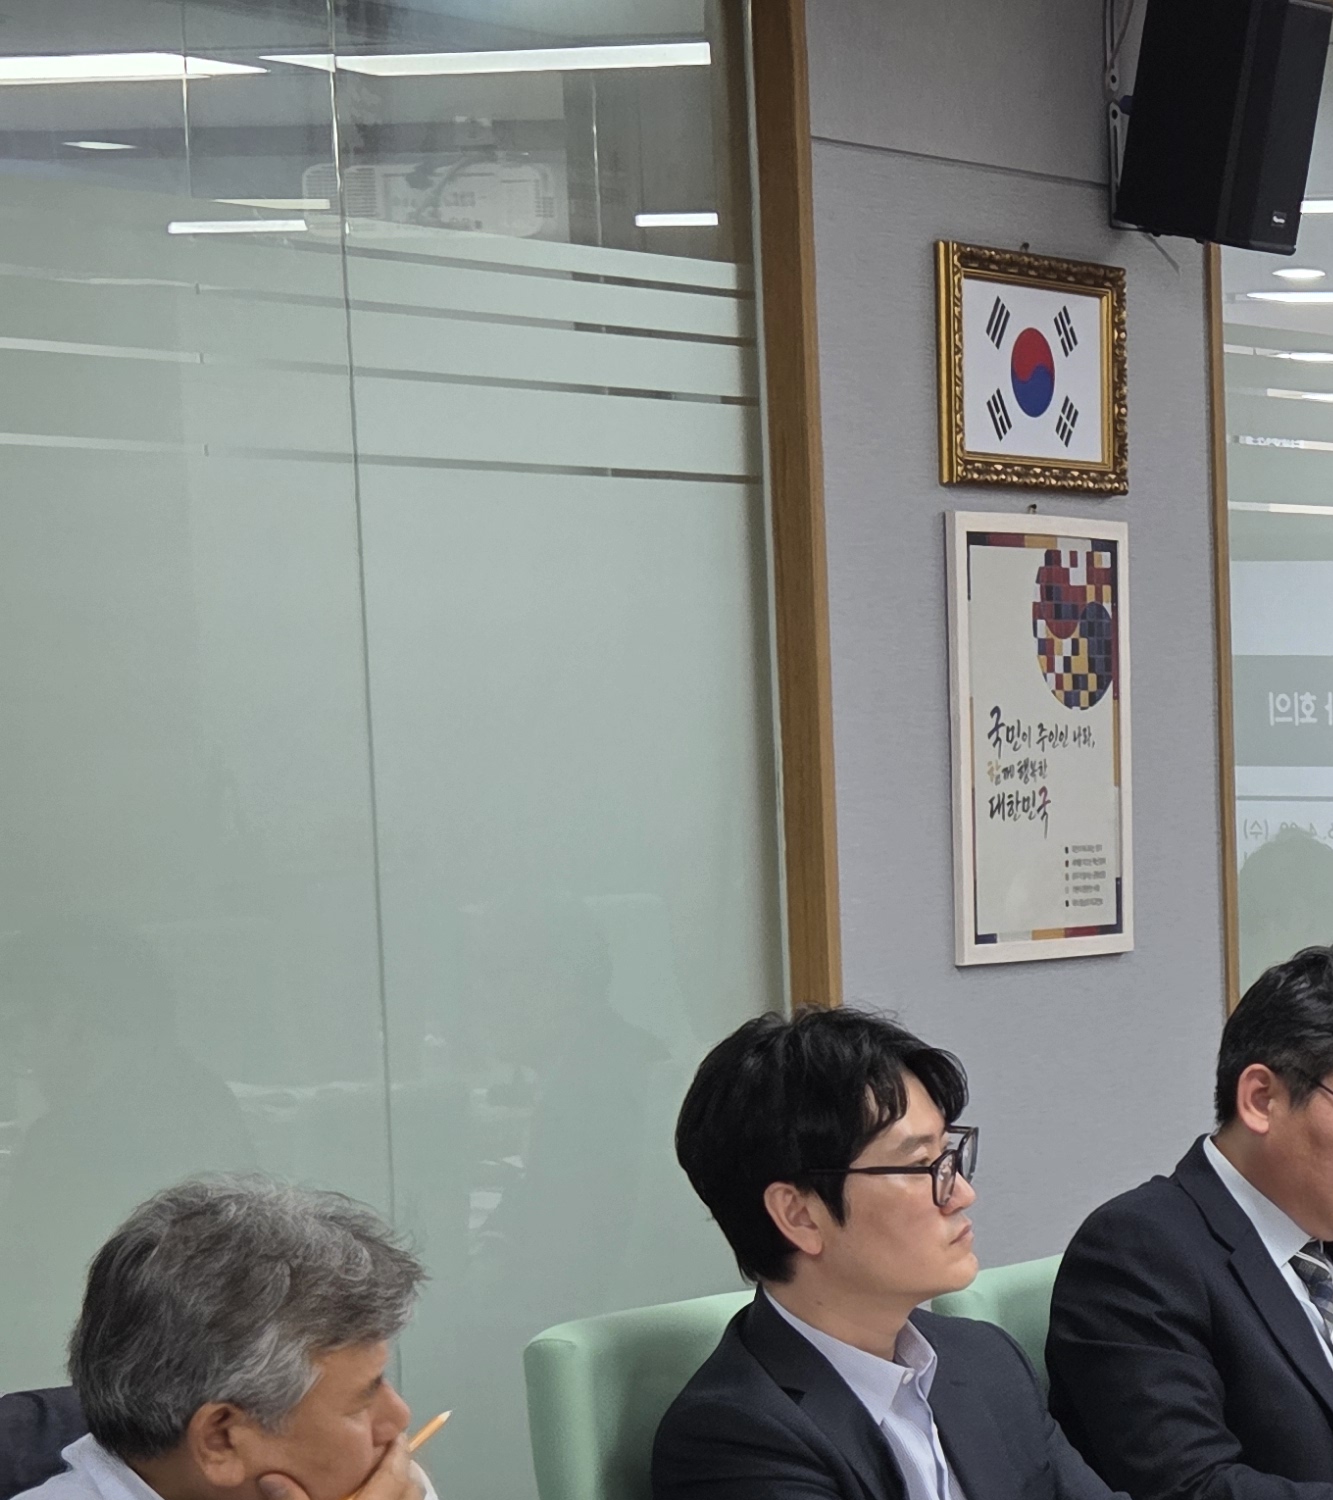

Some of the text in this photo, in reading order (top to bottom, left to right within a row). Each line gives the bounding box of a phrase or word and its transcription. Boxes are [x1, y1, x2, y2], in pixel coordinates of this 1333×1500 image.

[988, 705, 1031, 759] 국민이
[1036, 722, 1069, 752] 주인인
[1017, 757, 1047, 785] 행복한
[988, 786, 1051, 839] 대한민국
